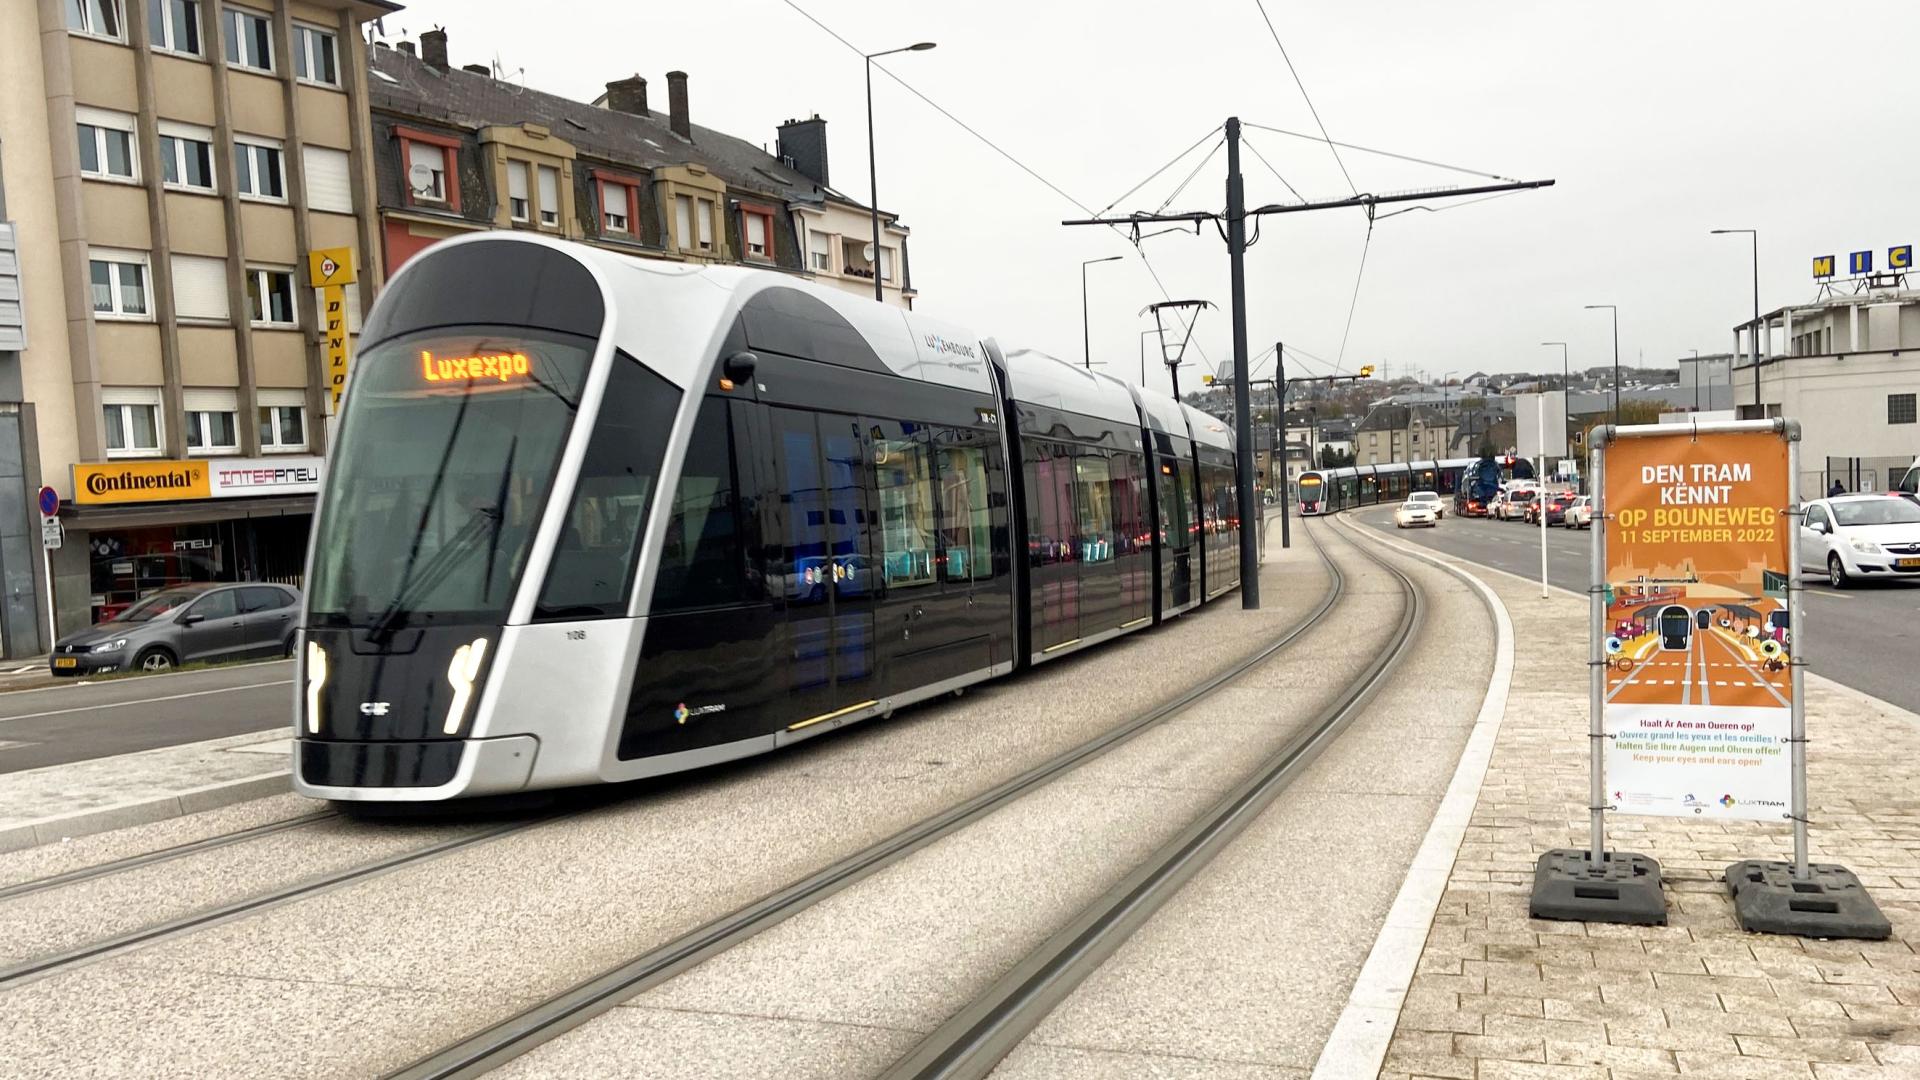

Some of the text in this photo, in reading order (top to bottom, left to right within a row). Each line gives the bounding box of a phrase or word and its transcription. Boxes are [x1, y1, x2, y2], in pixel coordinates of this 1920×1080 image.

[1813, 248, 1906, 276] MIC
[421, 350, 529, 382] Luxexpo
[1641, 463, 1751, 484] DEN TRAM
[86, 469, 192, 496] Continental
[1661, 482, 1732, 505] KËNNT
[1618, 506, 1775, 528] OP BOUNEWEG
[1620, 528, 1775, 544] 11 SEPTEMBER 2022
[173, 538, 213, 551] PNEU
[1640, 719, 1662, 728] Haalt
[1676, 720, 1693, 729] Aen
[1707, 721, 1739, 730] Oueren
[1740, 723, 1755, 732] op!
[1619, 730, 1648, 739] Ouvrez
[1650, 731, 1675, 741] grand
[1676, 731, 1689, 740] les
[1691, 734, 1711, 742] yeux
[1713, 733, 1722, 741] et
[1724, 733, 1738, 742] les
[1740, 734, 1772, 743] oreilles
[1615, 741, 1781, 756] Halten Sie Ihre Augen und Ohren offen!
[1633, 753, 1654, 764] Keep
[1656, 755, 1674, 764] your
[1676, 756, 1697, 765] eyes
[1698, 756, 1715, 764] and
[1738, 758, 1762, 767] open!
[1737, 799, 1785, 808] LUXTRAM
